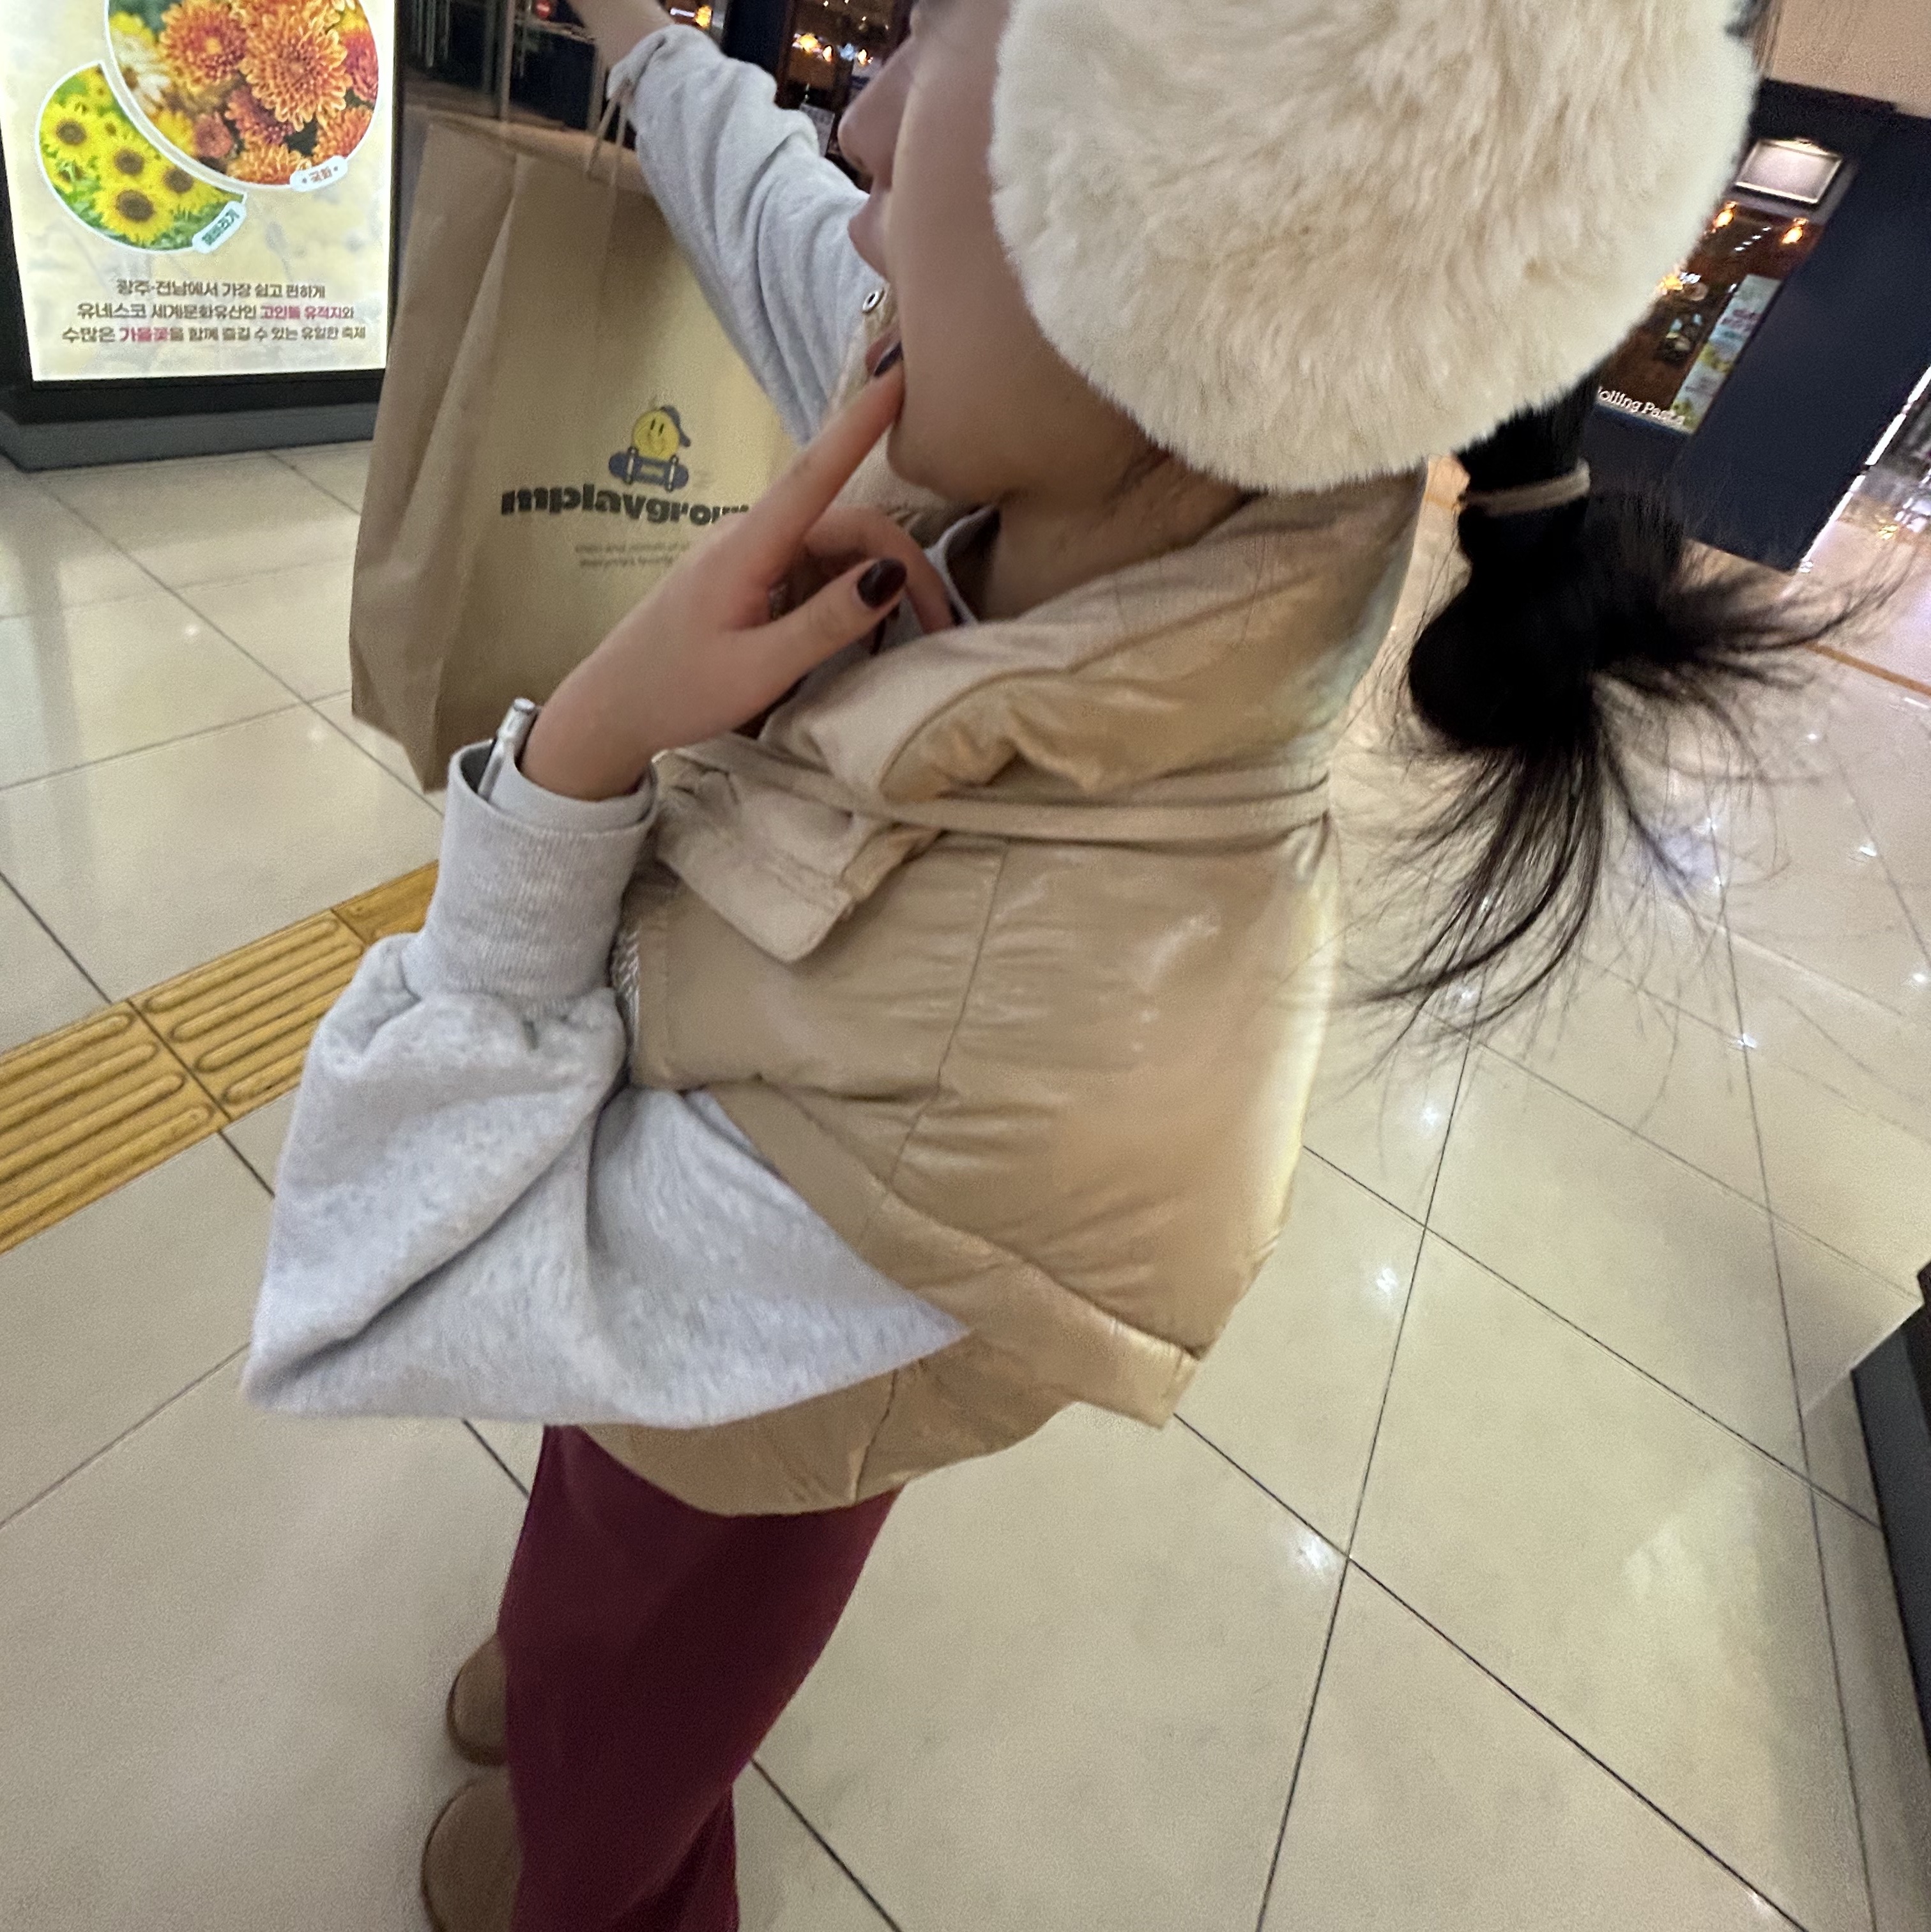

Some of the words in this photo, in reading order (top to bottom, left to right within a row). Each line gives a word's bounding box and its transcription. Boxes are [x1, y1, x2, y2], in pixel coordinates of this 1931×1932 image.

[222, 282, 251, 298] 가장
[256, 284, 282, 298] 쉽고
[286, 284, 325, 298] 편하게
[77, 303, 147, 319] 유네스코
[151, 303, 256, 319] 세계문화유산인
[305, 305, 354, 319] 유적지와
[63, 327, 116, 343] 수많은
[188, 326, 218, 341] 함께
[224, 326, 250, 341] 즐길
[254, 327, 268, 342] 수
[271, 327, 298, 341] 있는
[301, 326, 339, 341] 유일한
[342, 326, 367, 340] 축제
[1598, 386, 1644, 413] olling
[501, 483, 749, 525] mplaygro
